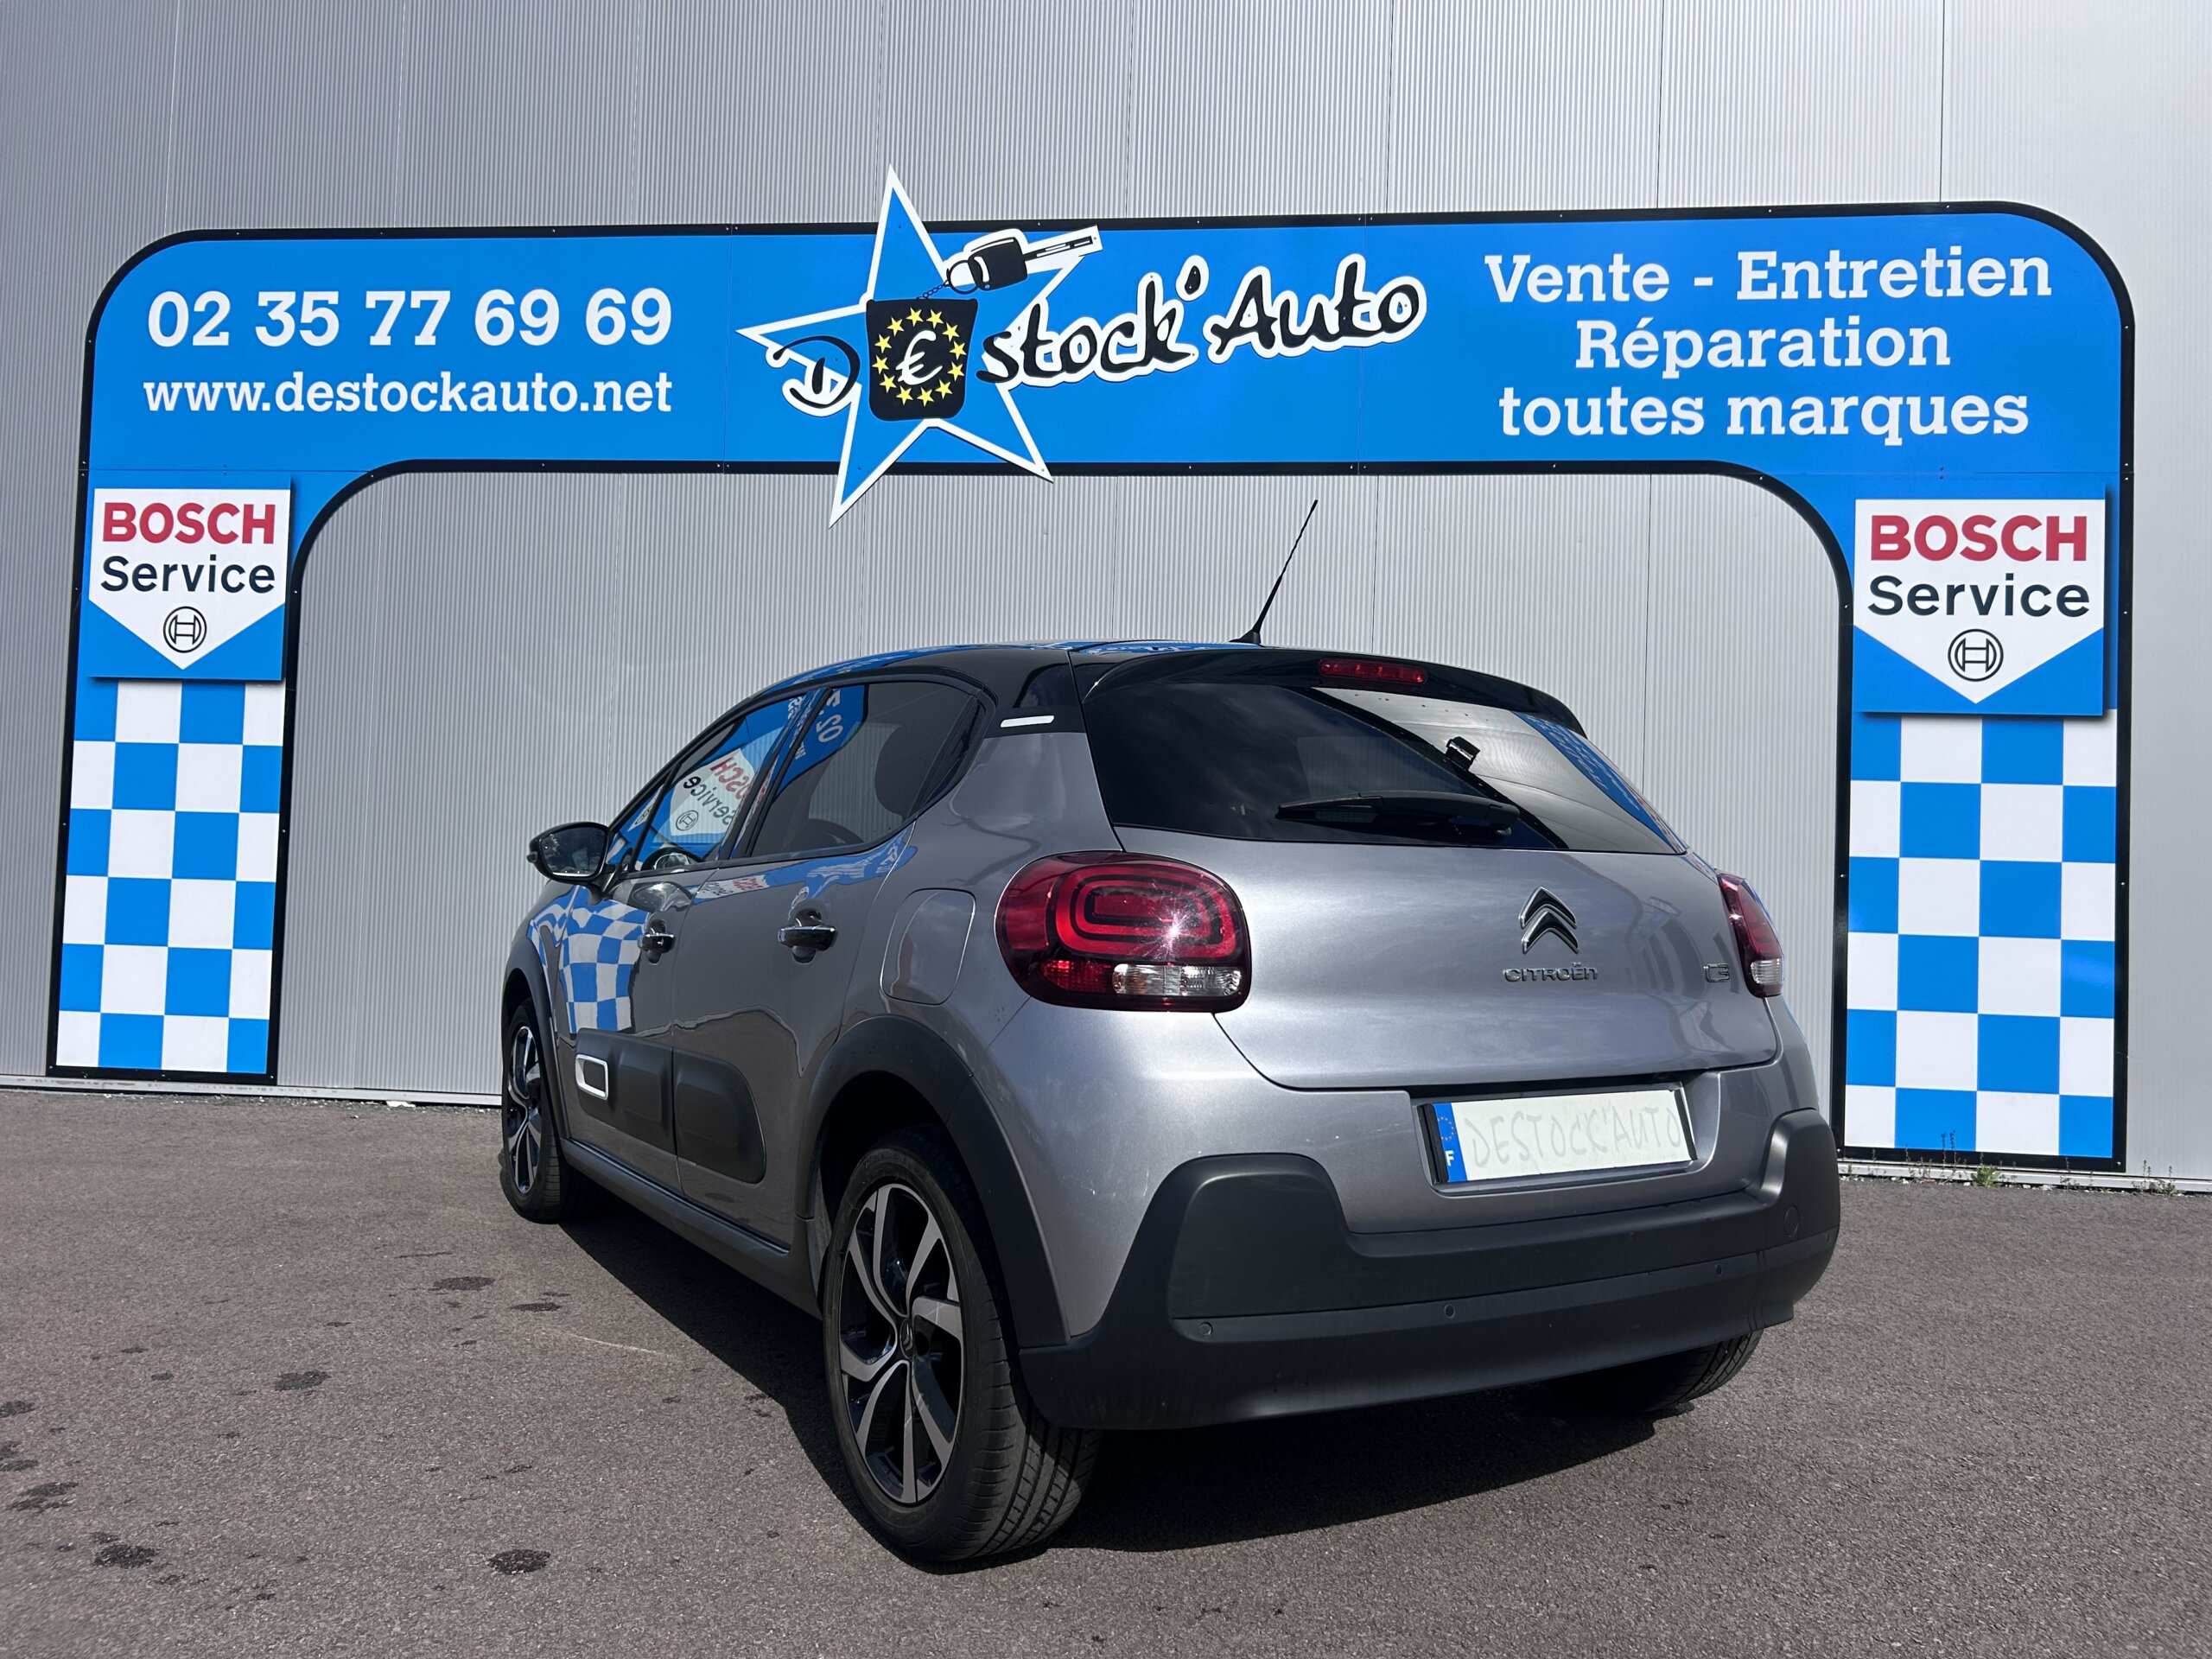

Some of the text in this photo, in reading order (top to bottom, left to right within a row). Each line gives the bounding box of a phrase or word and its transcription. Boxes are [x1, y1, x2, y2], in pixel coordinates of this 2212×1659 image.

[1484, 252, 1669, 303] Vente
[1737, 245, 2052, 300] Entretien
[148, 288, 671, 347] 02 35 77 69 69
[1575, 315, 1951, 379] Réparation
[143, 371, 672, 412] www.destockauto.net
[1498, 386, 2029, 446] toutes marques
[102, 501, 276, 544] BOSCH
[1871, 514, 2087, 562] BOSCH
[100, 554, 275, 594] Service
[1868, 572, 2089, 618] Service
[1445, 1150, 1455, 1166] F
